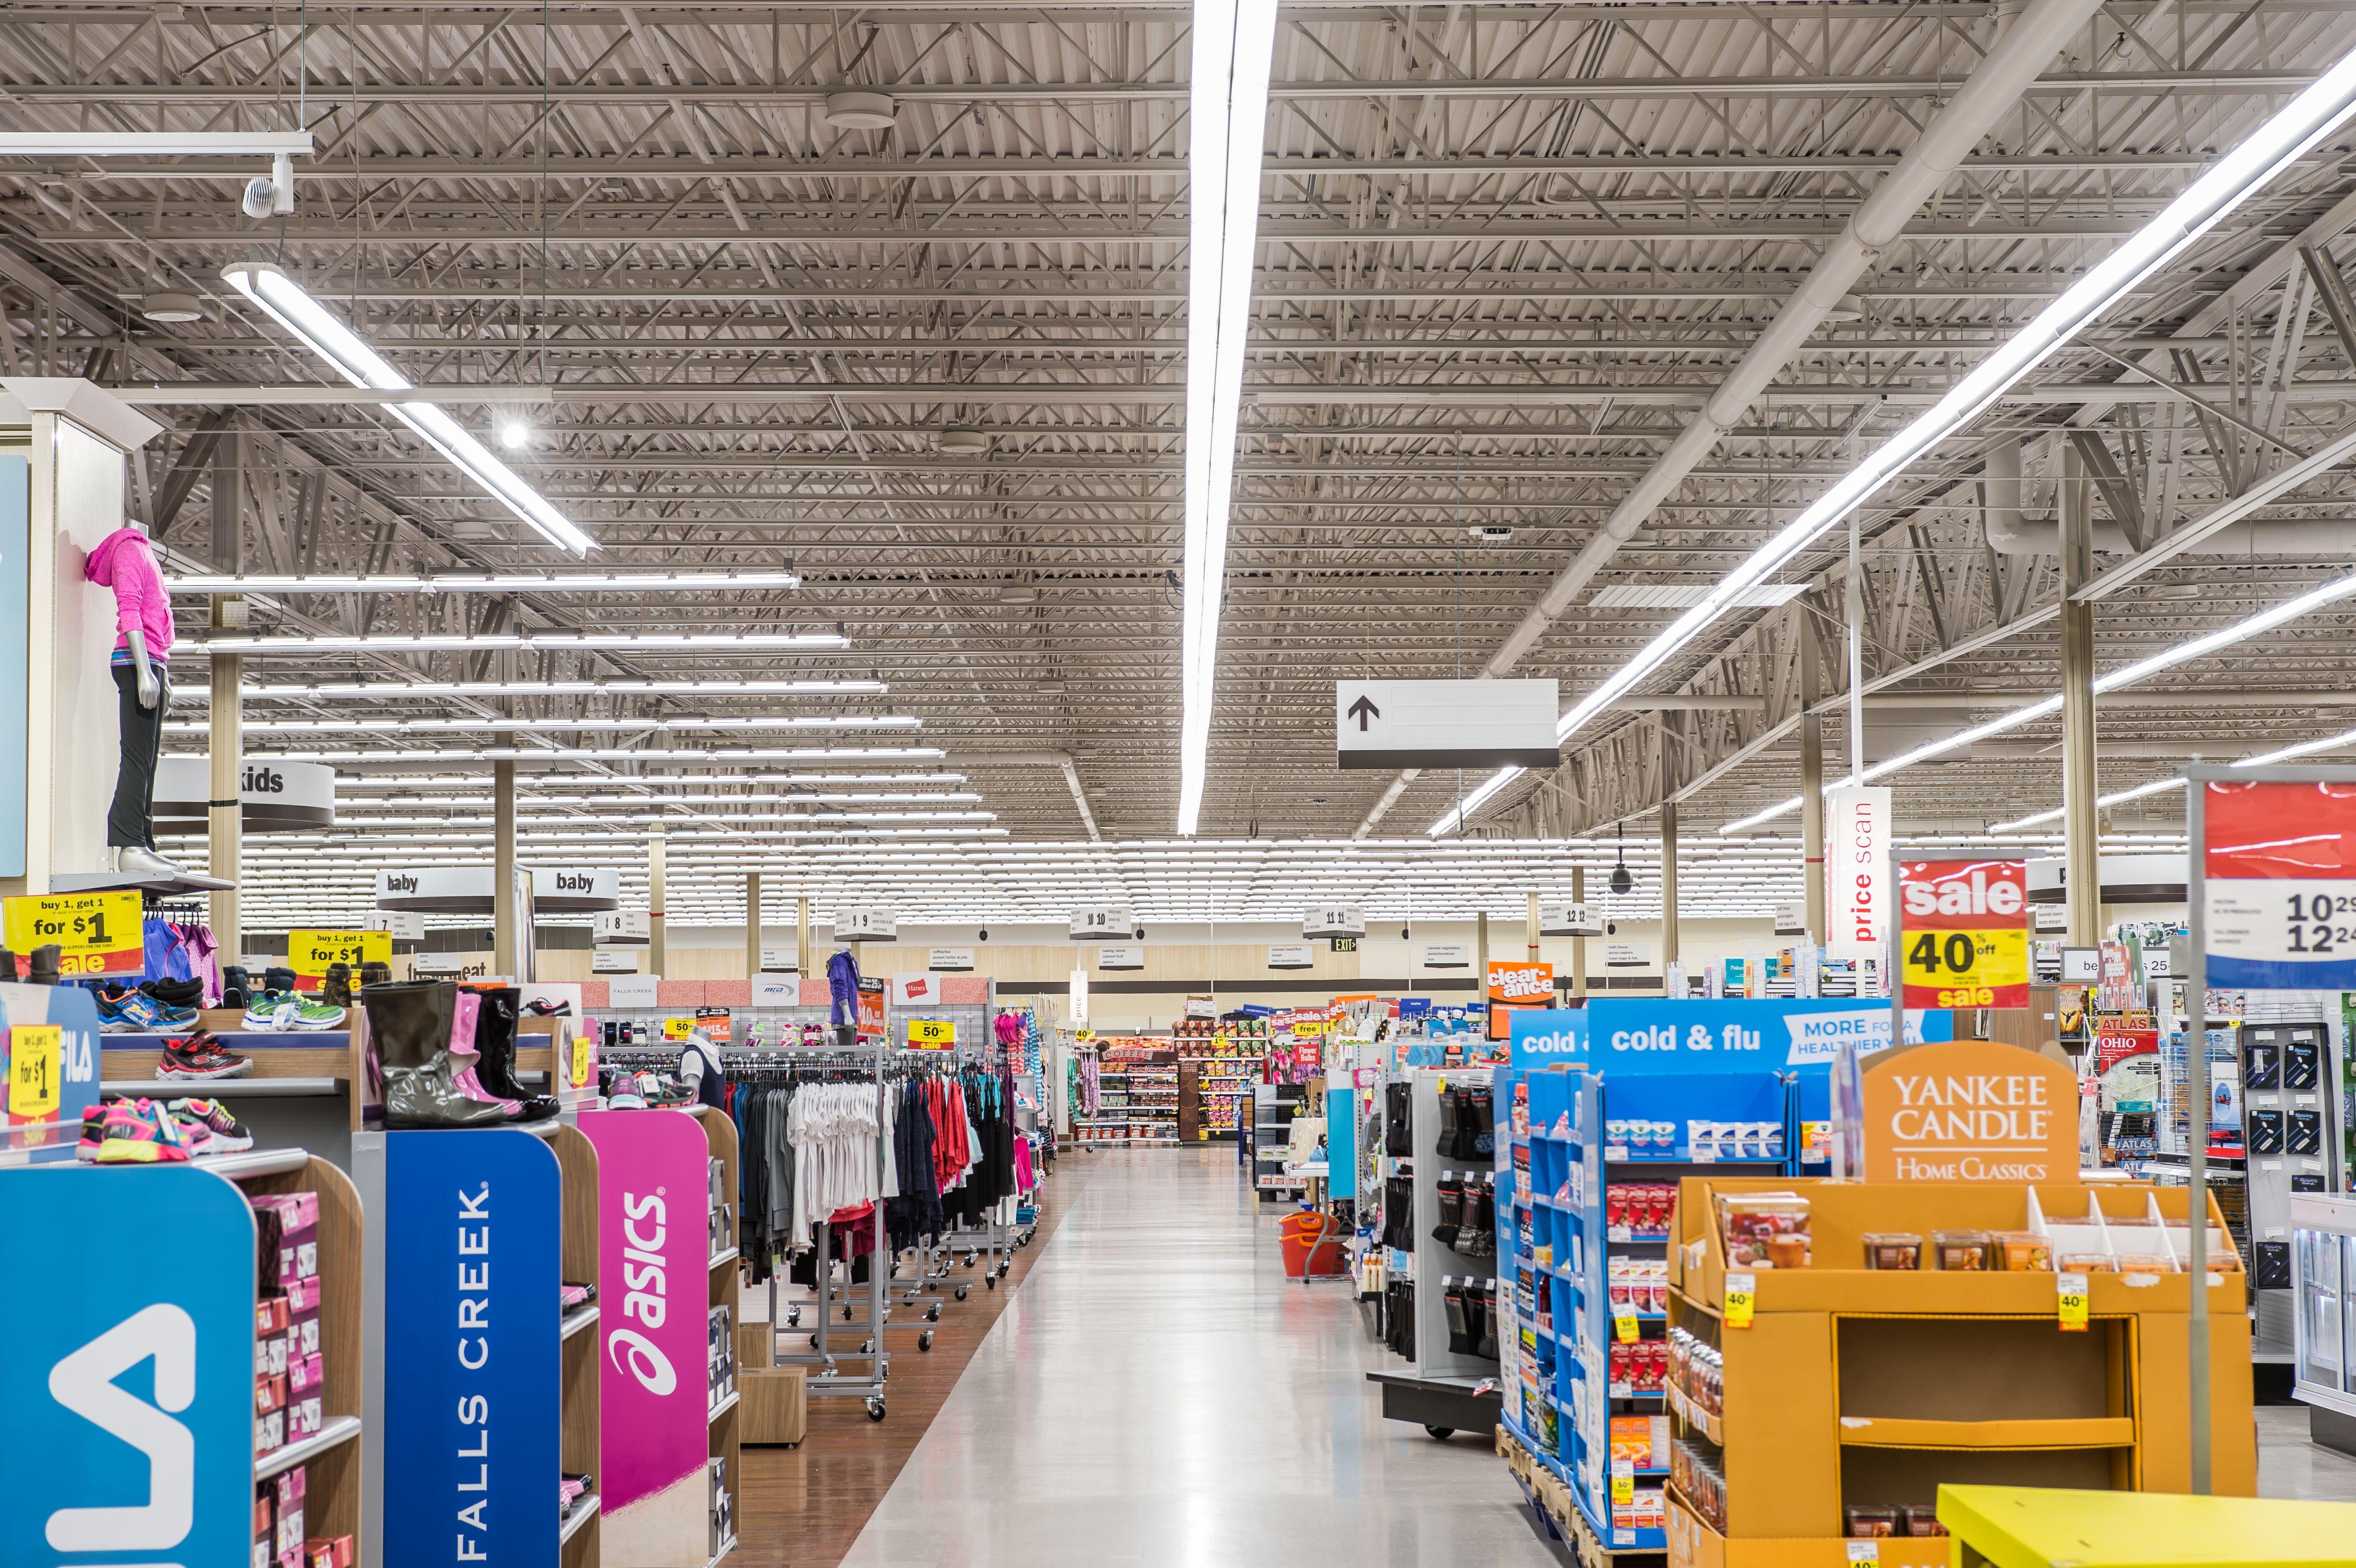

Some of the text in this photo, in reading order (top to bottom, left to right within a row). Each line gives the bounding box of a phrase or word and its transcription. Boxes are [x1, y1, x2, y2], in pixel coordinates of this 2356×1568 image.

[1851, 802, 1876, 942] price scan
[387, 874, 418, 893] baby
[556, 872, 594, 894] baby
[1904, 871, 2022, 915] sale
[41, 898, 104, 910] buy 1, get 1
[863, 915, 867, 926] 9
[1088, 913, 1093, 925] 10
[1097, 913, 1105, 925] 10
[1327, 912, 1335, 924] 11
[1567, 910, 1576, 922] 12
[1579, 910, 1585, 922] 12
[34, 912, 112, 944] for $1
[615, 917, 620, 929] 8
[1336, 939, 1352, 951] EXIT
[1976, 945, 1996, 955] off
[311, 946, 363, 969] for $1
[57, 954, 105, 975] ale
[1488, 968, 1546, 987] clear-
[1503, 979, 1554, 998] ance
[1938, 987, 1994, 1008] sale
[873, 1016, 883, 1026] less
[1296, 1011, 1321, 1021] sale
[1804, 1019, 1866, 1037] MORE
[1872, 1022, 1893, 1033] FO
[2102, 1019, 2148, 1029] ATLAS
[923, 1027, 939, 1036] 50
[1612, 1024, 1760, 1051] cold & flu
[1523, 1031, 1575, 1053] cold
[2101, 1037, 2137, 1048] OHIO
[1105, 1050, 1150, 1058] COFFEE
[21, 1061, 32, 1083] for
[1892, 1076, 2047, 1105] YANKEE
[1892, 1110, 2048, 1140] CANDLE
[2122, 1140, 2152, 1149] ATLAS
[1728, 1294, 1745, 1304] 40
[2062, 1296, 2079, 1307] 40
[457, 1188, 489, 1561] FALLS CREEK
